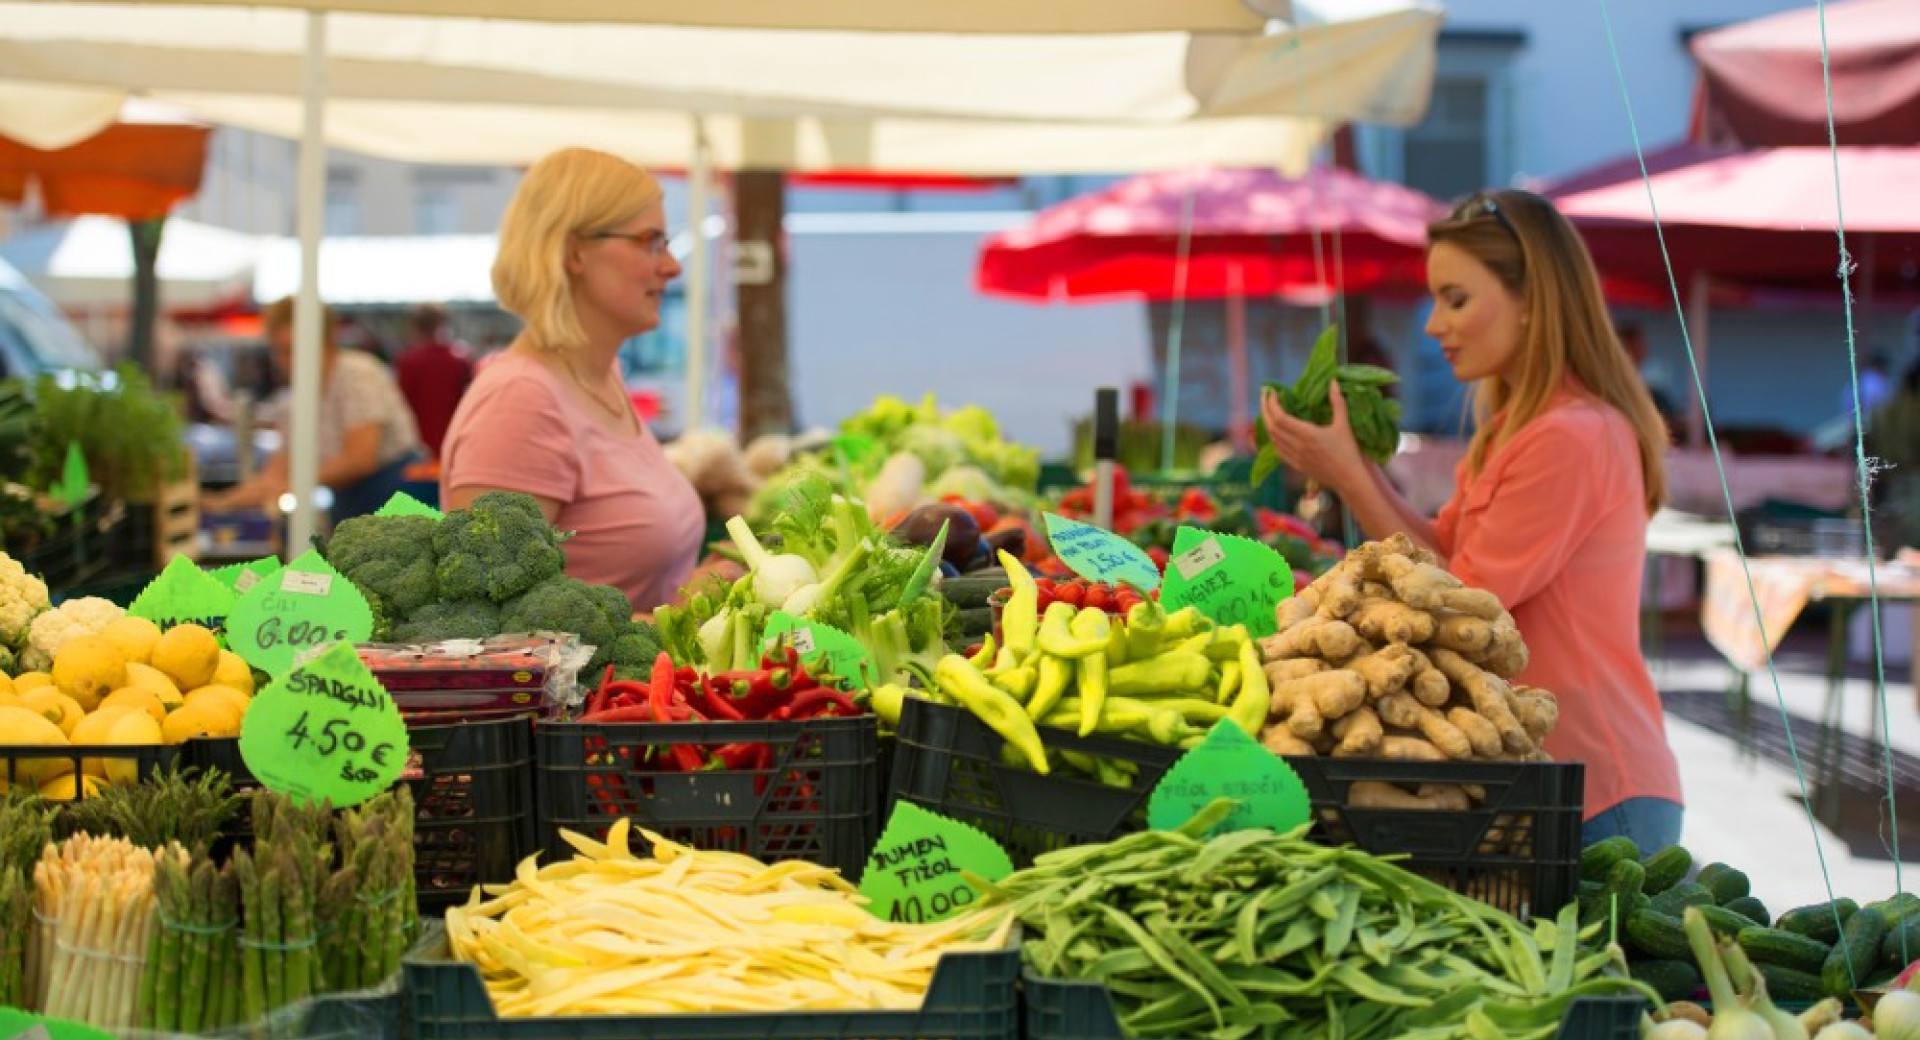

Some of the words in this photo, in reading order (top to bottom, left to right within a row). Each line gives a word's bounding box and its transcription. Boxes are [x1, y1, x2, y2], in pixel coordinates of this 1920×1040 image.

[256, 616, 328, 650] 6.00
[285, 710, 366, 756] 4.50
[371, 743, 394, 766] €
[890, 884, 975, 924] 10.00
